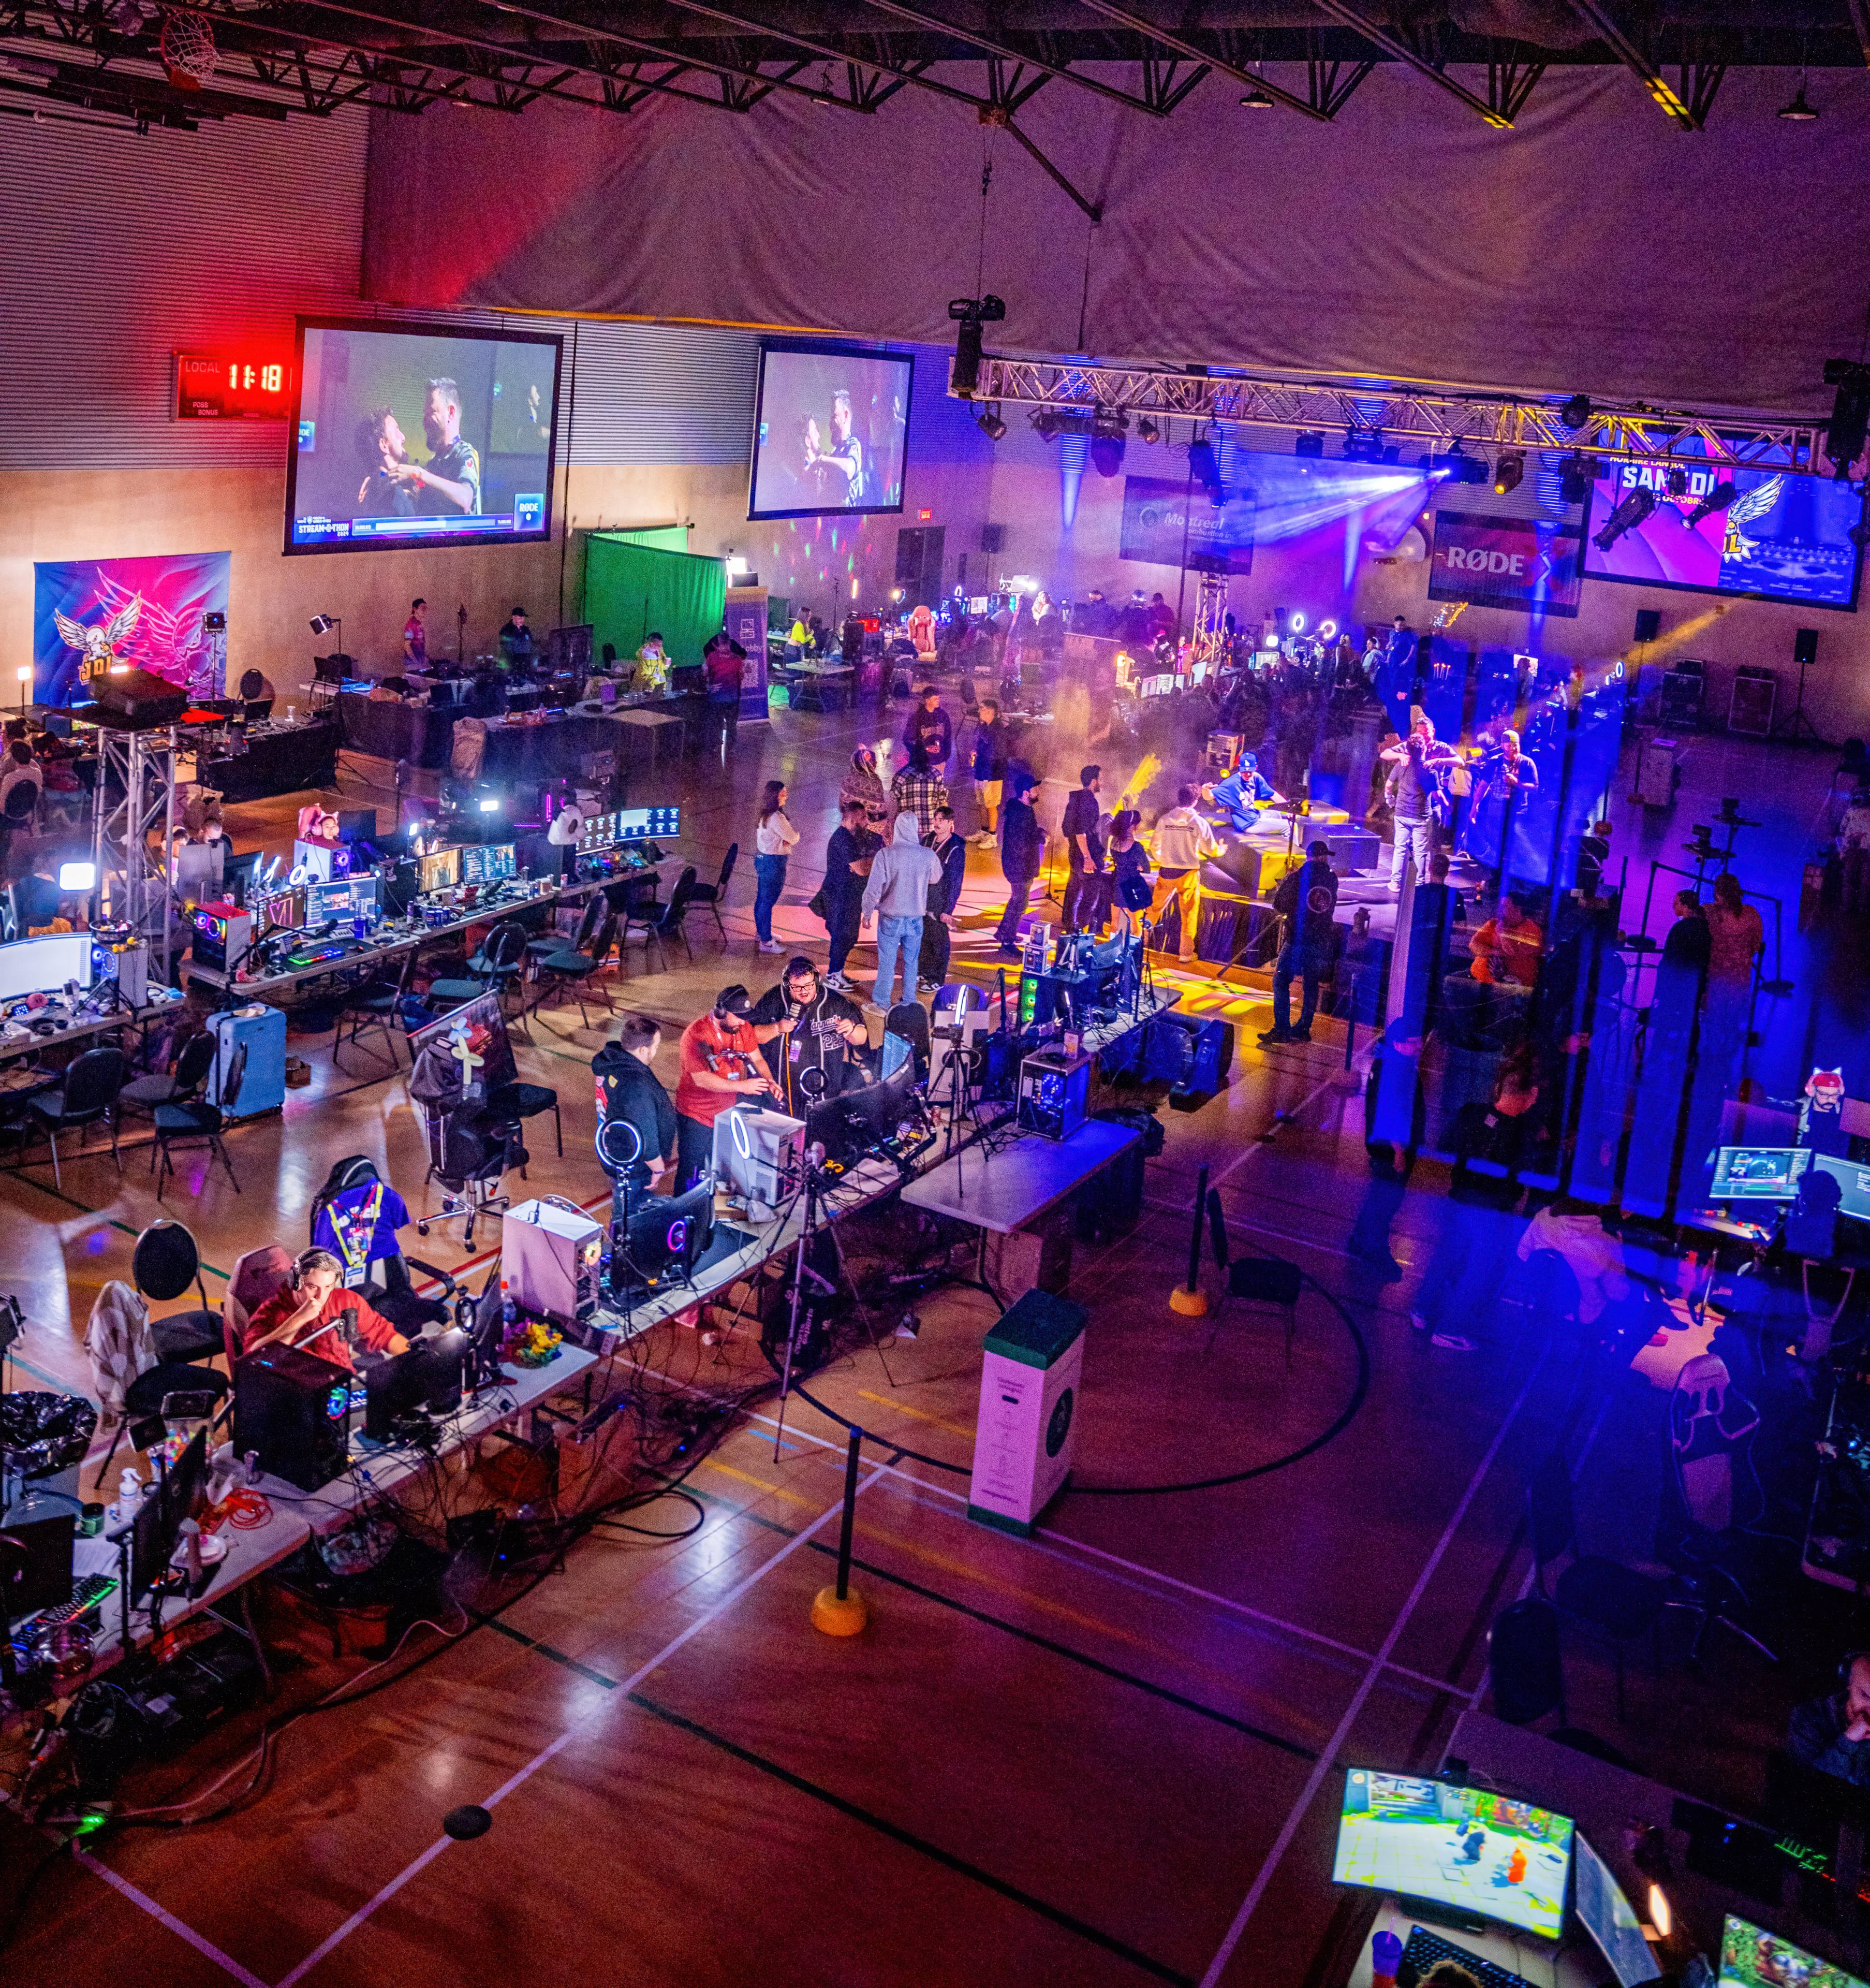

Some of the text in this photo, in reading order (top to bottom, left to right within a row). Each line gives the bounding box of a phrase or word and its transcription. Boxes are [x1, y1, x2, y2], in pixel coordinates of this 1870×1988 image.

[185, 361, 220, 373] LOCAL
[229, 364, 282, 391] 11:18
[1623, 466, 1715, 496] SAMDI
[1662, 495, 1702, 505] OCTOBR
[1447, 546, 1524, 576] RØDE
